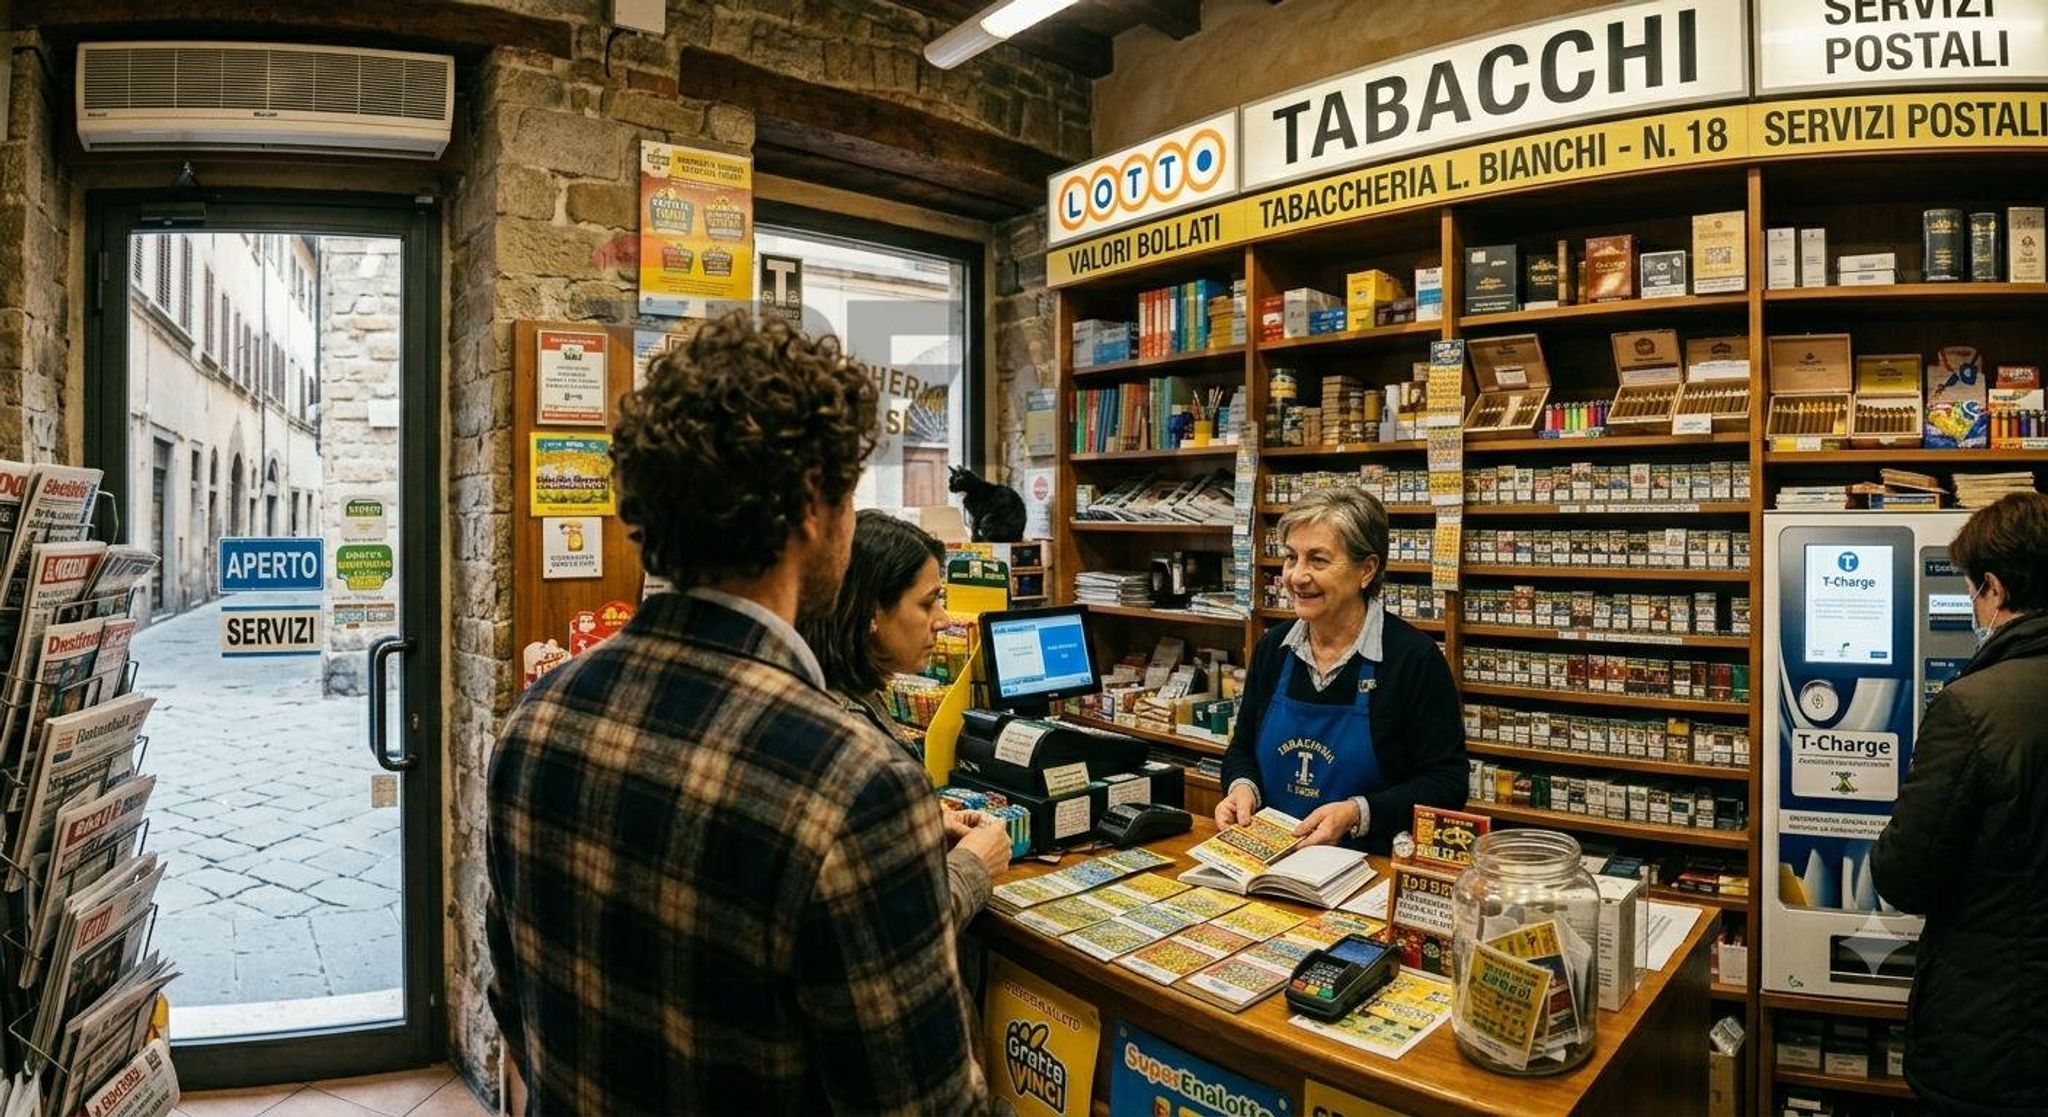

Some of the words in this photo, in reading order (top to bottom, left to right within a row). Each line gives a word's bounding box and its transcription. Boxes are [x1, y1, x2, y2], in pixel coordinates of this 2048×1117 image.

[1825, 0, 1994, 25] SERVIZI
[1826, 30, 2009, 74] POSTALI
[1272, 8, 1698, 165] TABACCHI
[1765, 105, 1894, 146] SERVIZI
[1908, 101, 2048, 138] POSTALI
[1259, 164, 1437, 228] TABACCHERIA
[1447, 158, 1470, 191] L.
[1480, 132, 1606, 185] BIANCHI
[1643, 124, 1676, 160] N.
[1687, 118, 1728, 154] 18
[1068, 236, 1131, 275] VALORI
[1137, 213, 1220, 259] BOLLATI
[226, 551, 317, 579] APERTO
[1822, 576, 1876, 591] T-Charge
[227, 616, 314, 646] SERVIZI
[1797, 734, 1891, 758] T-Charge
[1010, 1058, 1063, 1109] VINCI
